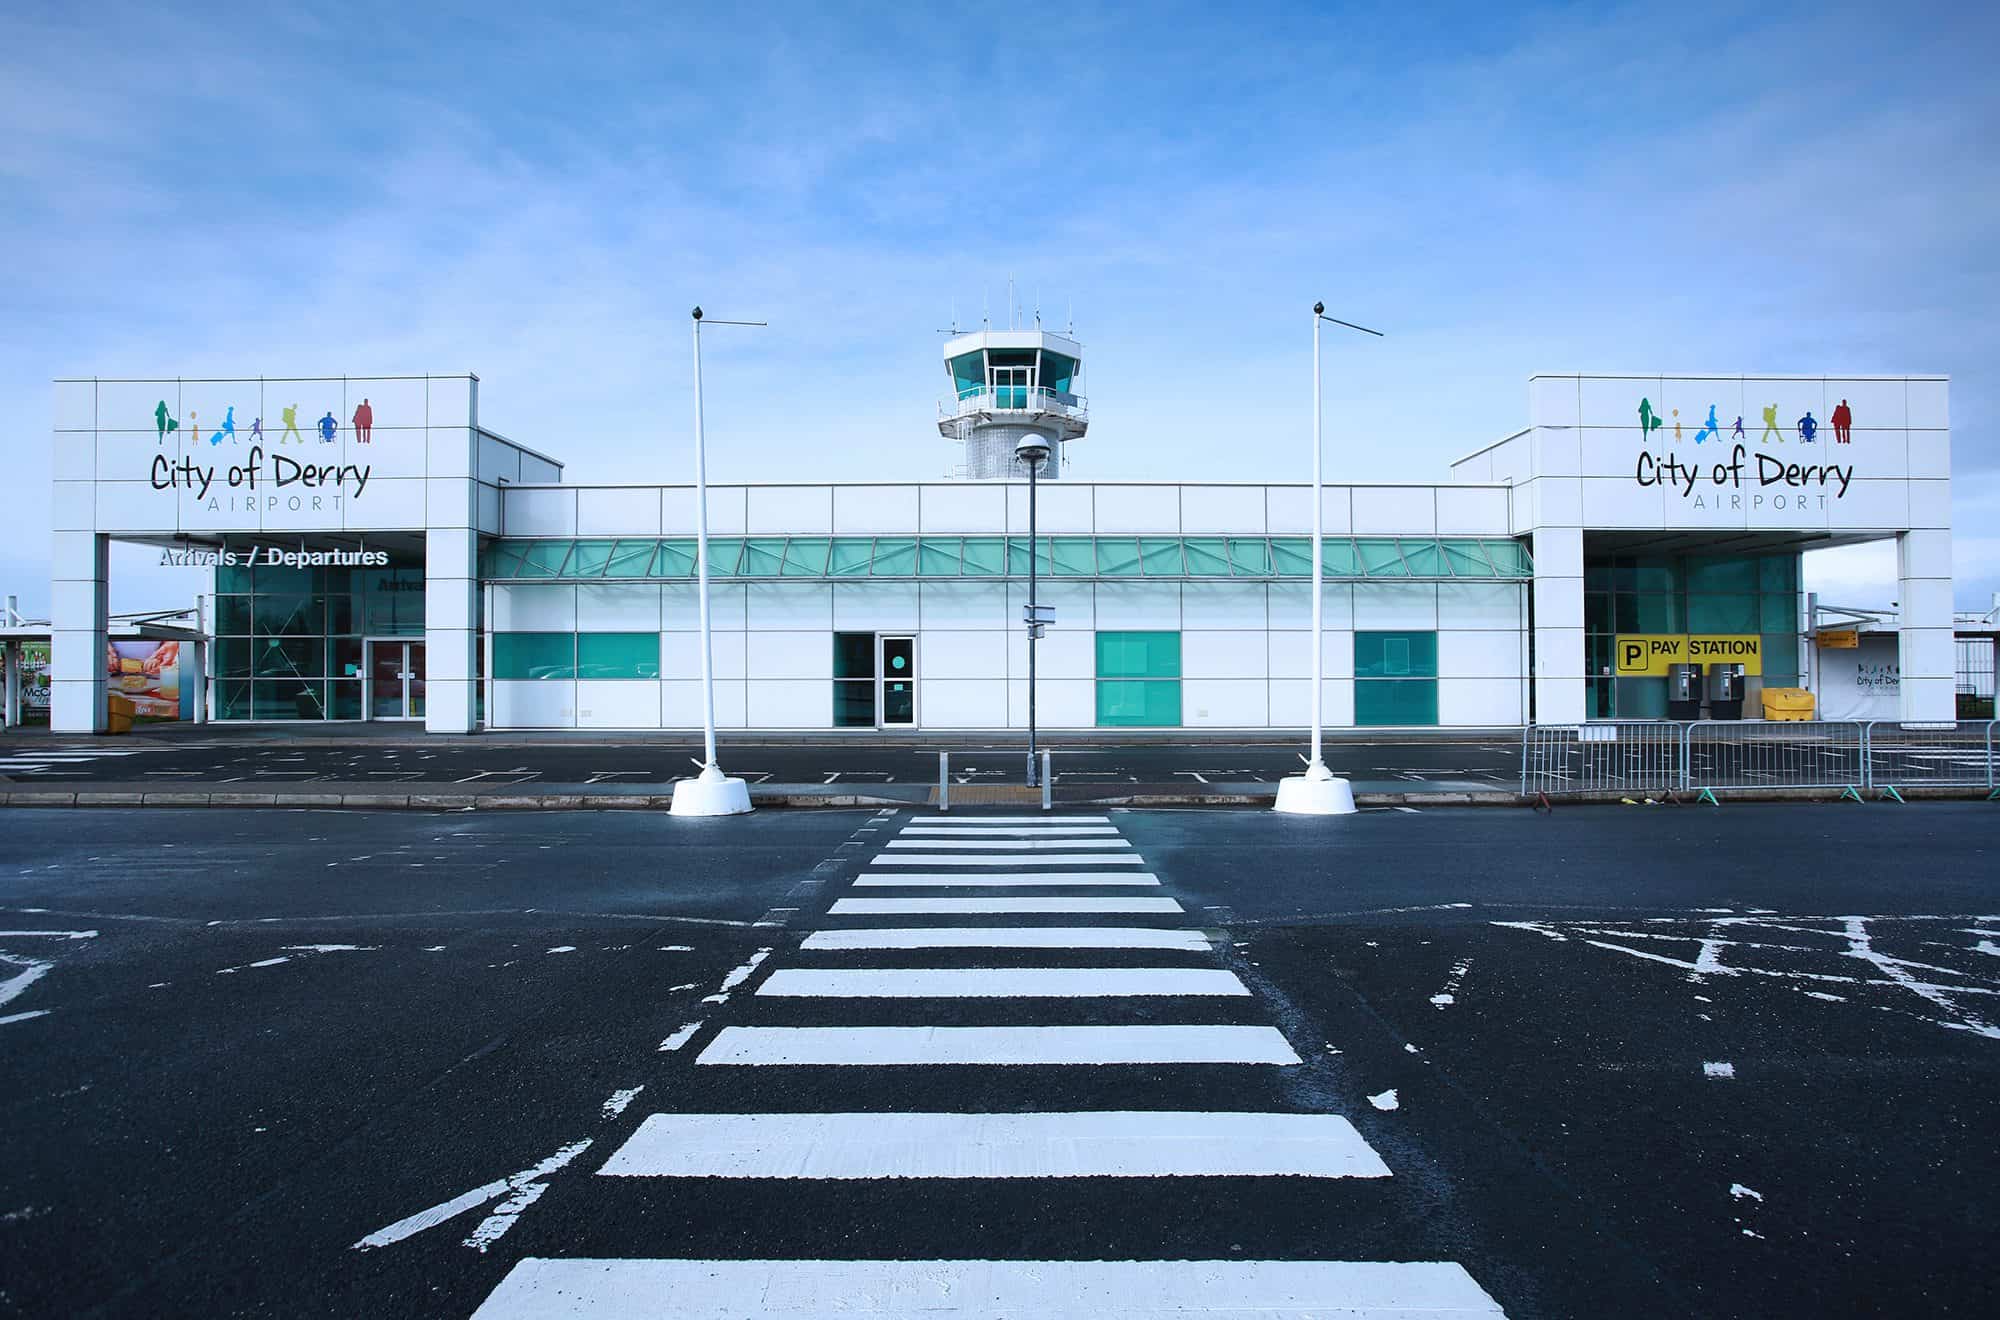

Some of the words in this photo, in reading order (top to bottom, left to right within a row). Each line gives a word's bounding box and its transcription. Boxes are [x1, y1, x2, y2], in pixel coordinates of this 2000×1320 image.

[151, 453, 214, 500] City
[228, 445, 264, 490] of
[271, 454, 371, 499] Derry
[1636, 451, 1698, 498] City
[1712, 443, 1746, 489] of
[1754, 452, 1853, 499] Derry
[207, 495, 342, 512] AIRPORT
[1693, 494, 1826, 510] AIRPORT
[159, 547, 238, 567] Arrivals
[268, 547, 389, 569] Departures
[1626, 645, 1642, 666] P
[1651, 640, 1681, 655] PAY
[1689, 640, 1758, 655] STATION
[1856, 676, 1873, 687] City
[1874, 674, 1884, 686] of
